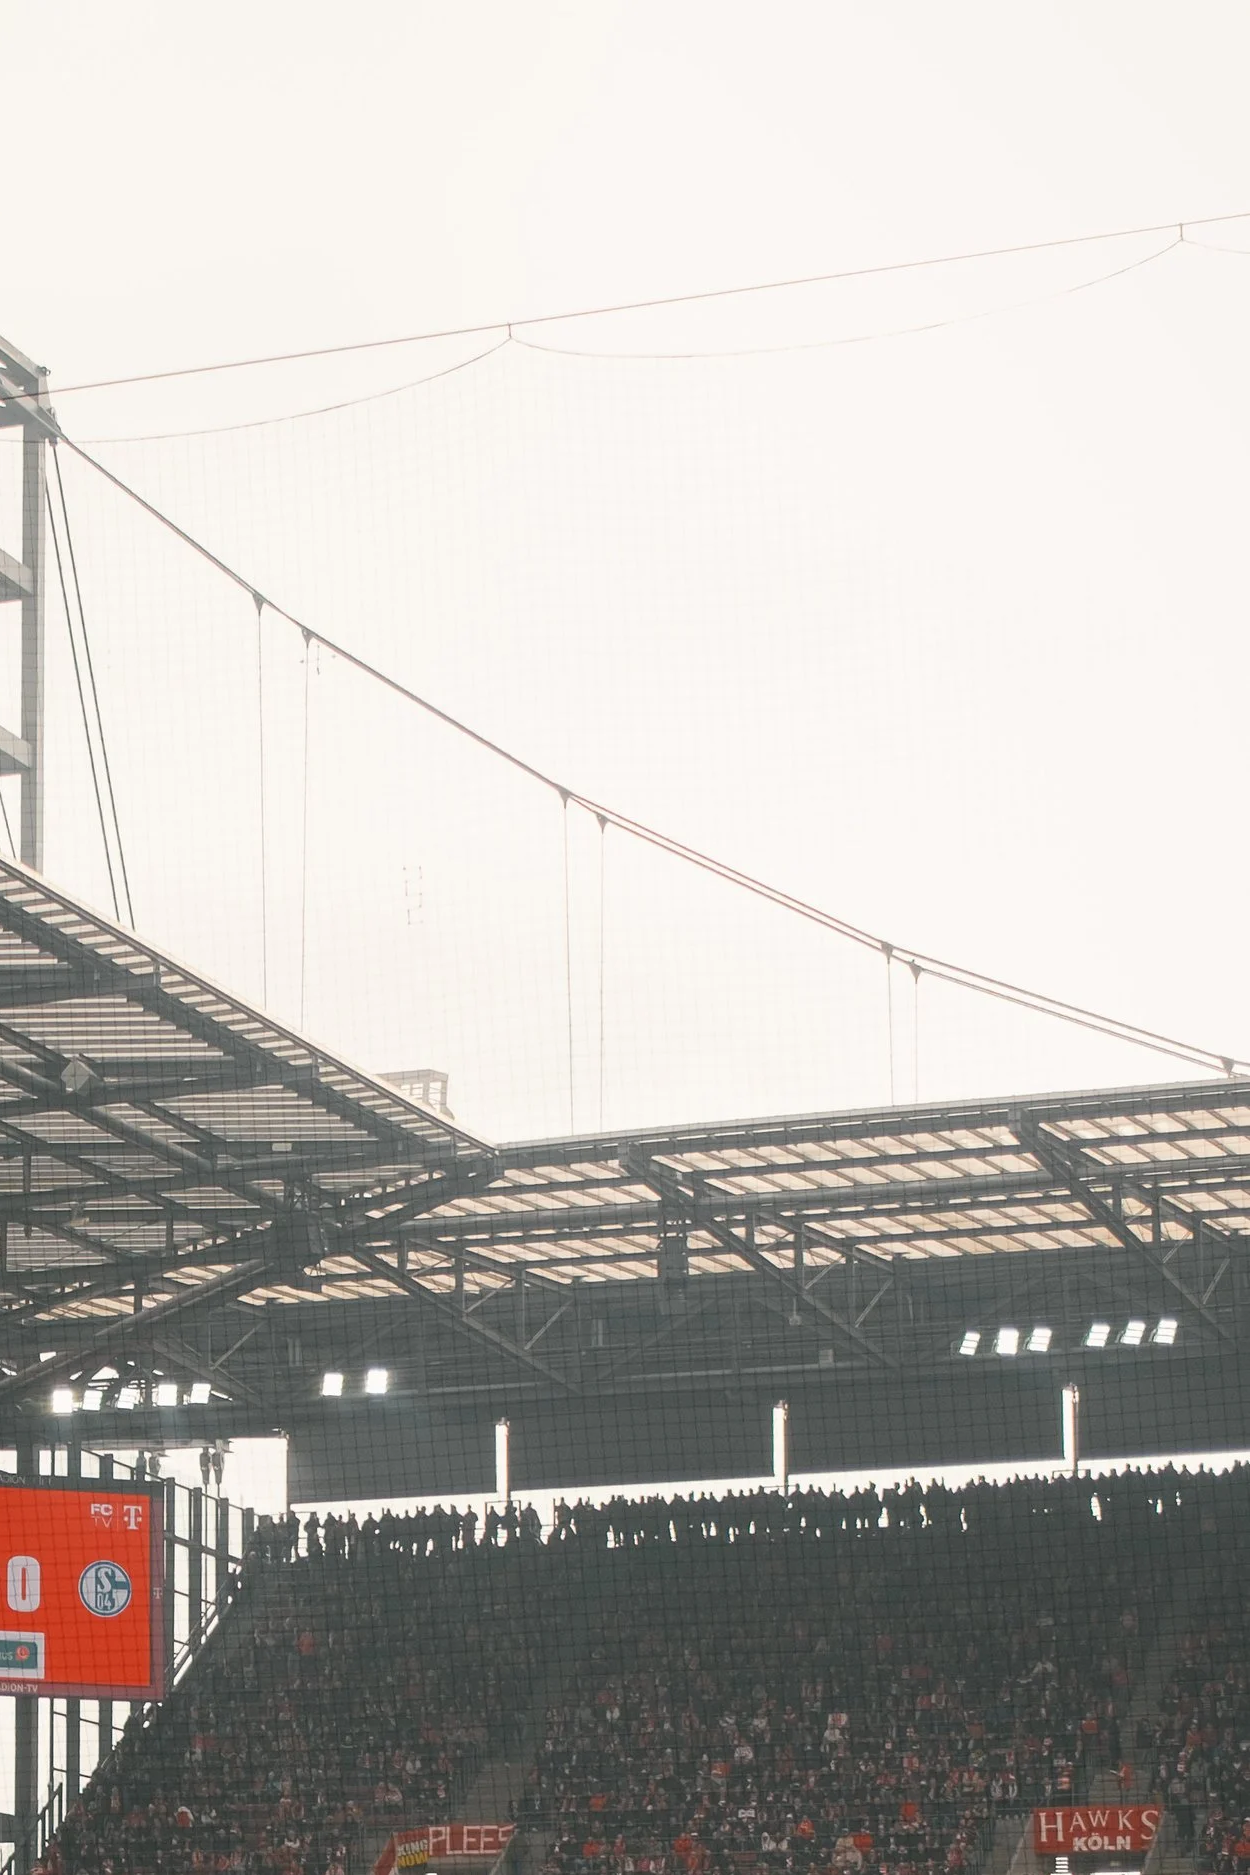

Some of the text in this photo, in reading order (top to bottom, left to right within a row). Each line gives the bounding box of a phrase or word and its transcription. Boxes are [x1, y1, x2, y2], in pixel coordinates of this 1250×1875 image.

[91, 1503, 113, 1516] FC
[92, 1516, 112, 1528] TV
[1038, 1809, 1159, 1842] HAWKS
[1072, 1832, 1131, 1851] KÖLN
